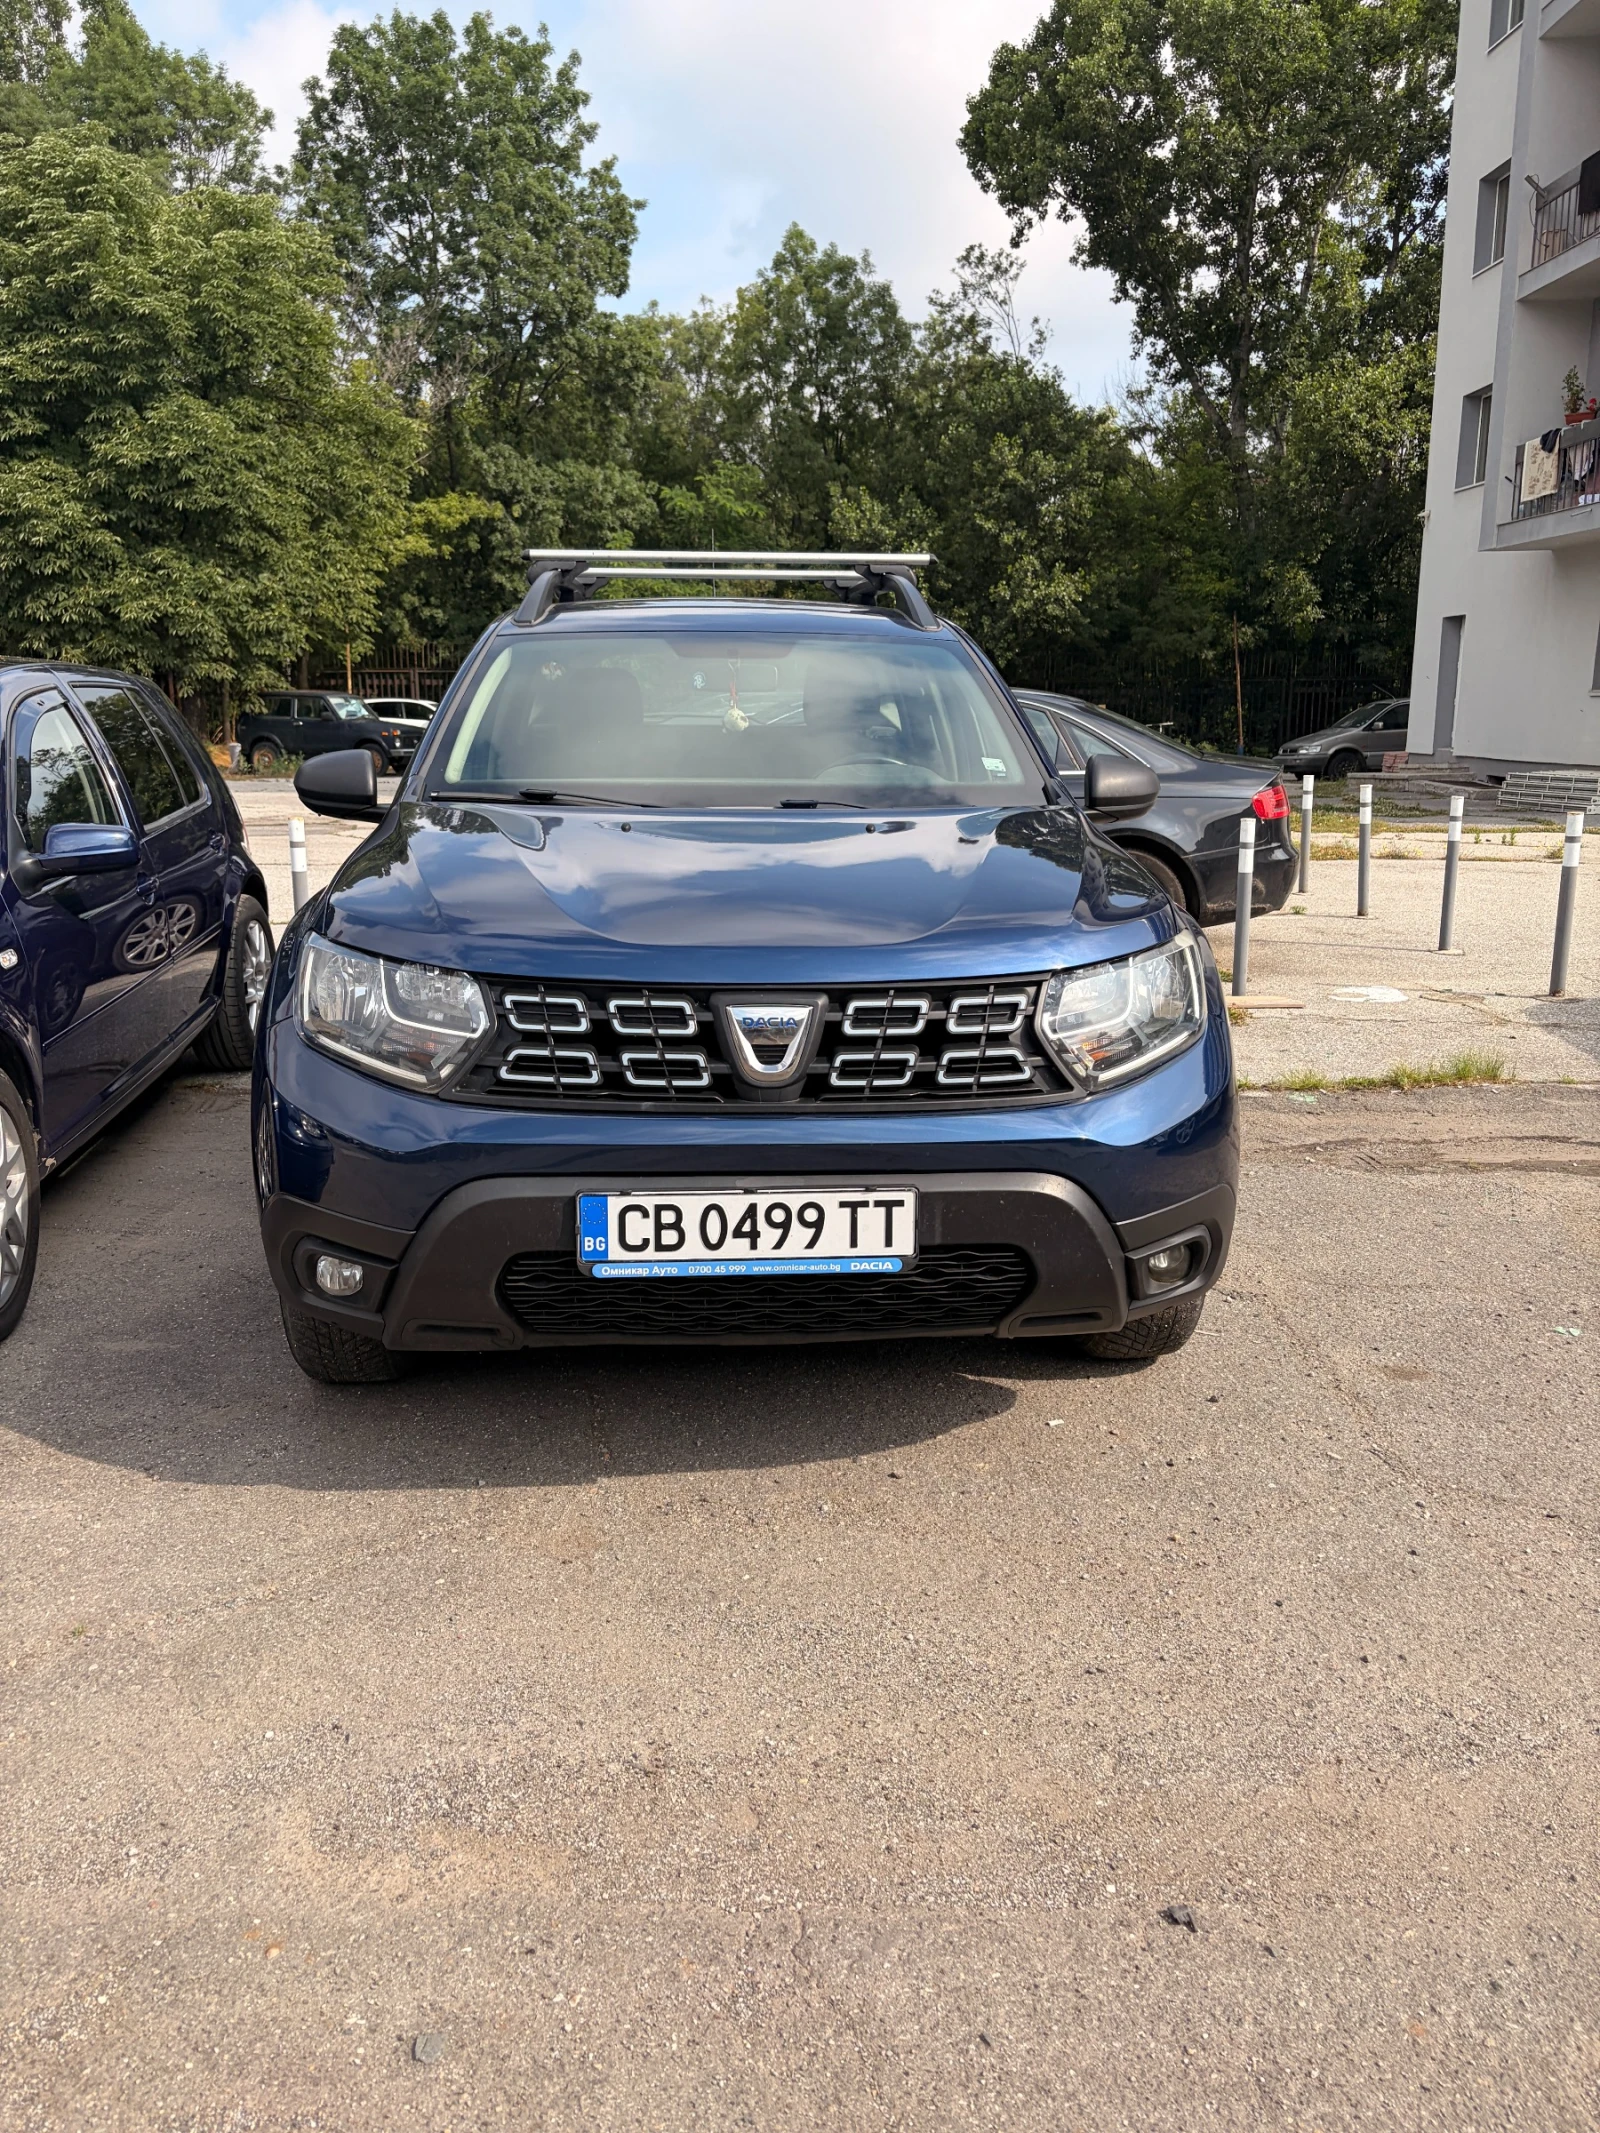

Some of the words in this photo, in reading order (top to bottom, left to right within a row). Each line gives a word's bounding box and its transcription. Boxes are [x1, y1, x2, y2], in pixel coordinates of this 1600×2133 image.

[742, 1017, 798, 1028] DACIA
[699, 1201, 826, 1252] 0499
[838, 1199, 905, 1249] TT
[584, 1237, 606, 1251] BG
[601, 1266, 650, 1277] Омникар
[652, 1265, 678, 1275] Ауто
[688, 1264, 712, 1274] 0700
[714, 1264, 727, 1273] 45
[729, 1264, 747, 1273] 999
[752, 1262, 841, 1273] www.omnicar-auto.bg
[850, 1261, 893, 1270] DACIA
